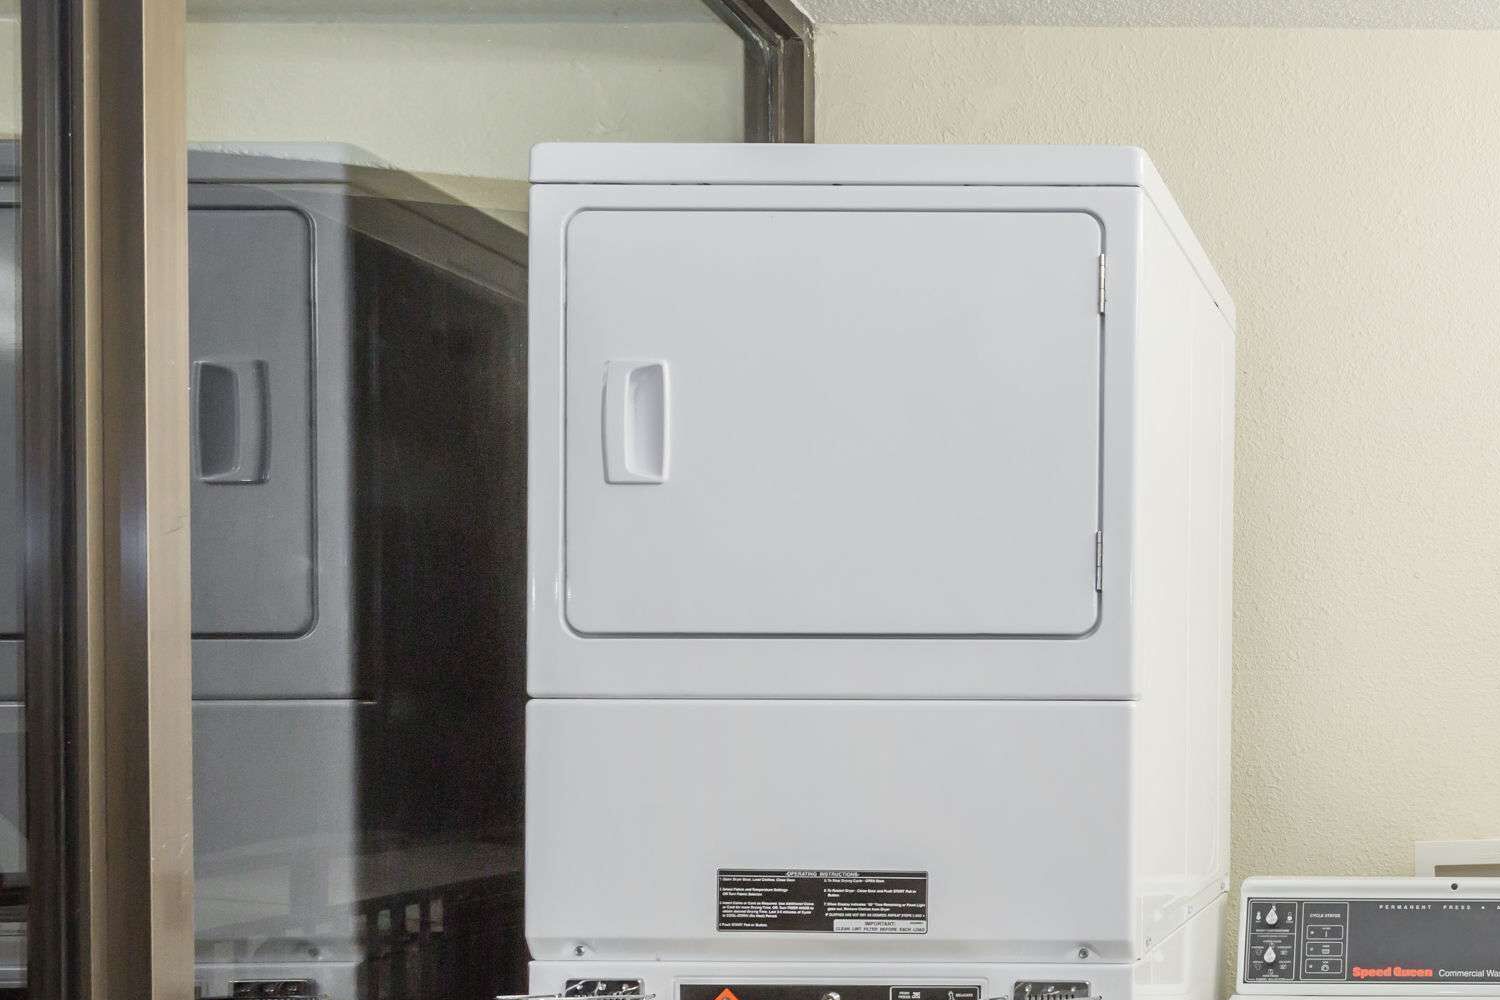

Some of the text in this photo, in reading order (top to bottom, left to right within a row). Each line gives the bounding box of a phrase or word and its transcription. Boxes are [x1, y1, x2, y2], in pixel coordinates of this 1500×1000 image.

[1351, 967, 1433, 979] Speed Queen
[1438, 968, 1485, 978] Commercial
